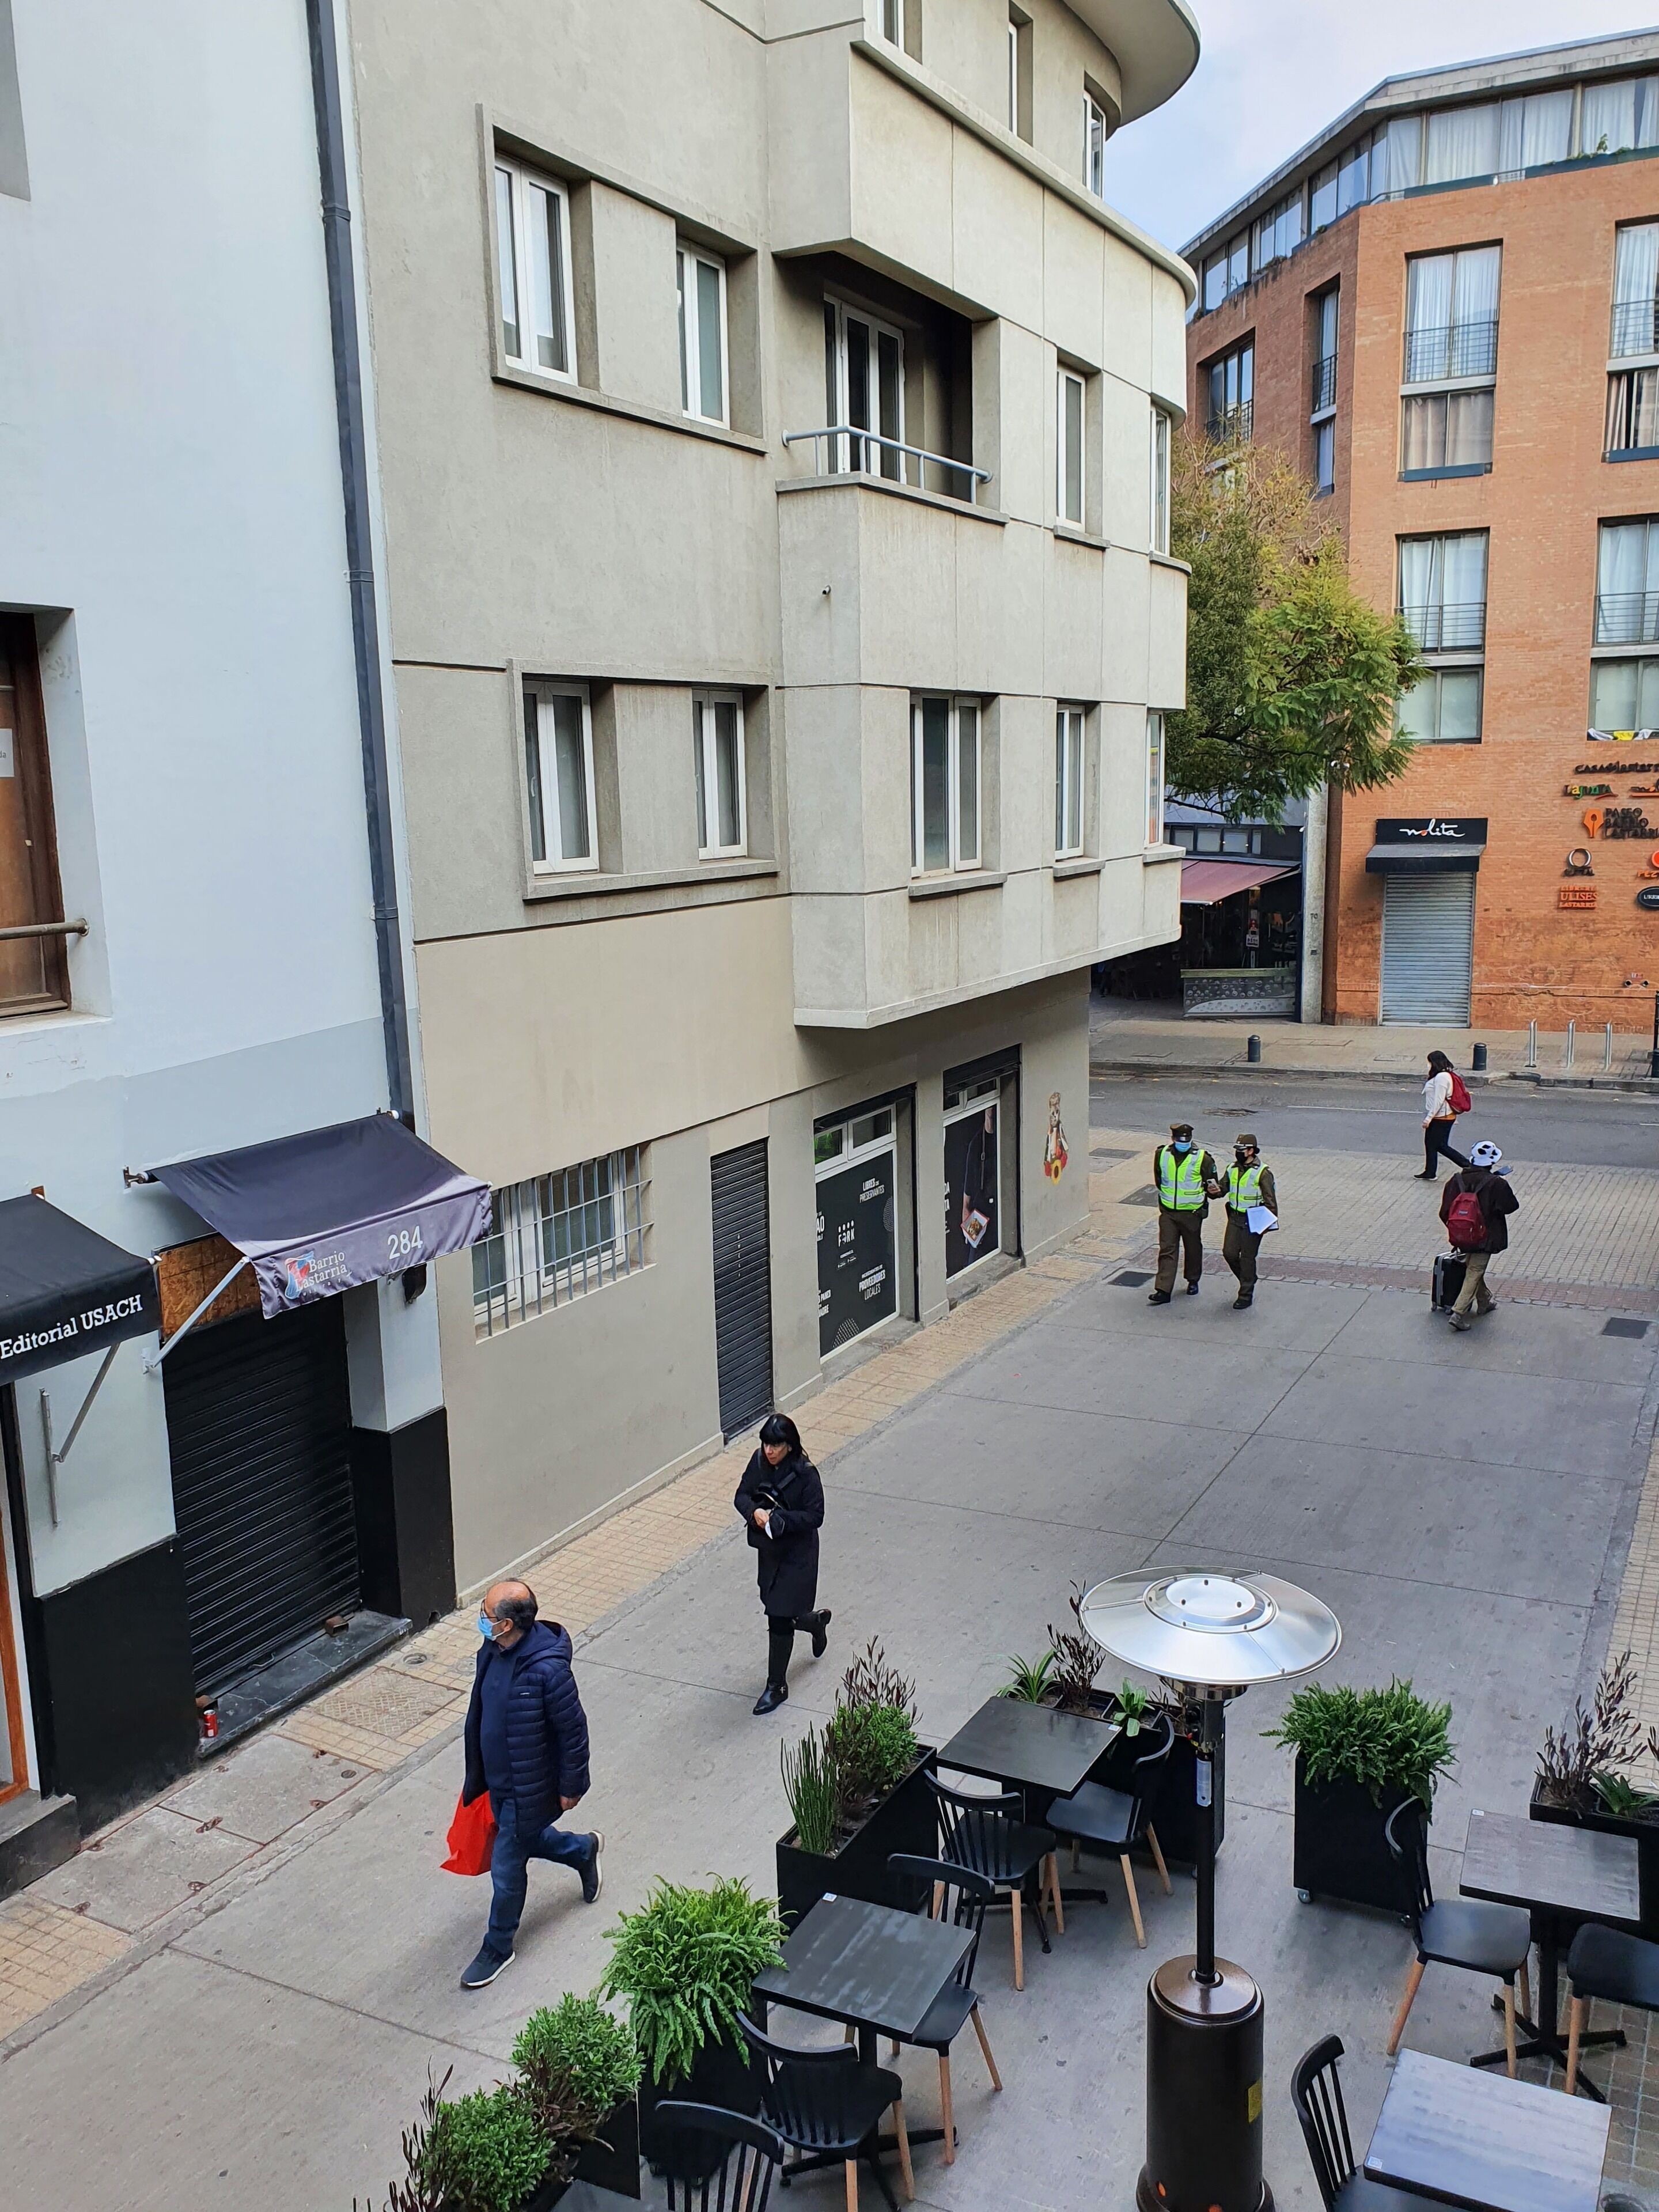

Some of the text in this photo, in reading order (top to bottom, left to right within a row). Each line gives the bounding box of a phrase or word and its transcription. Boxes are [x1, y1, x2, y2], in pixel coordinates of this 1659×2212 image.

[1399, 818, 1465, 837] nolita
[1560, 892, 1599, 901] ULISES
[387, 1225, 423, 1260] 284
[309, 1250, 346, 1273] Barrio
[294, 1262, 348, 1291] Lastarria
[864, 1283, 881, 1300] LOCALES
[0, 1294, 143, 1359] Editorial USACH
